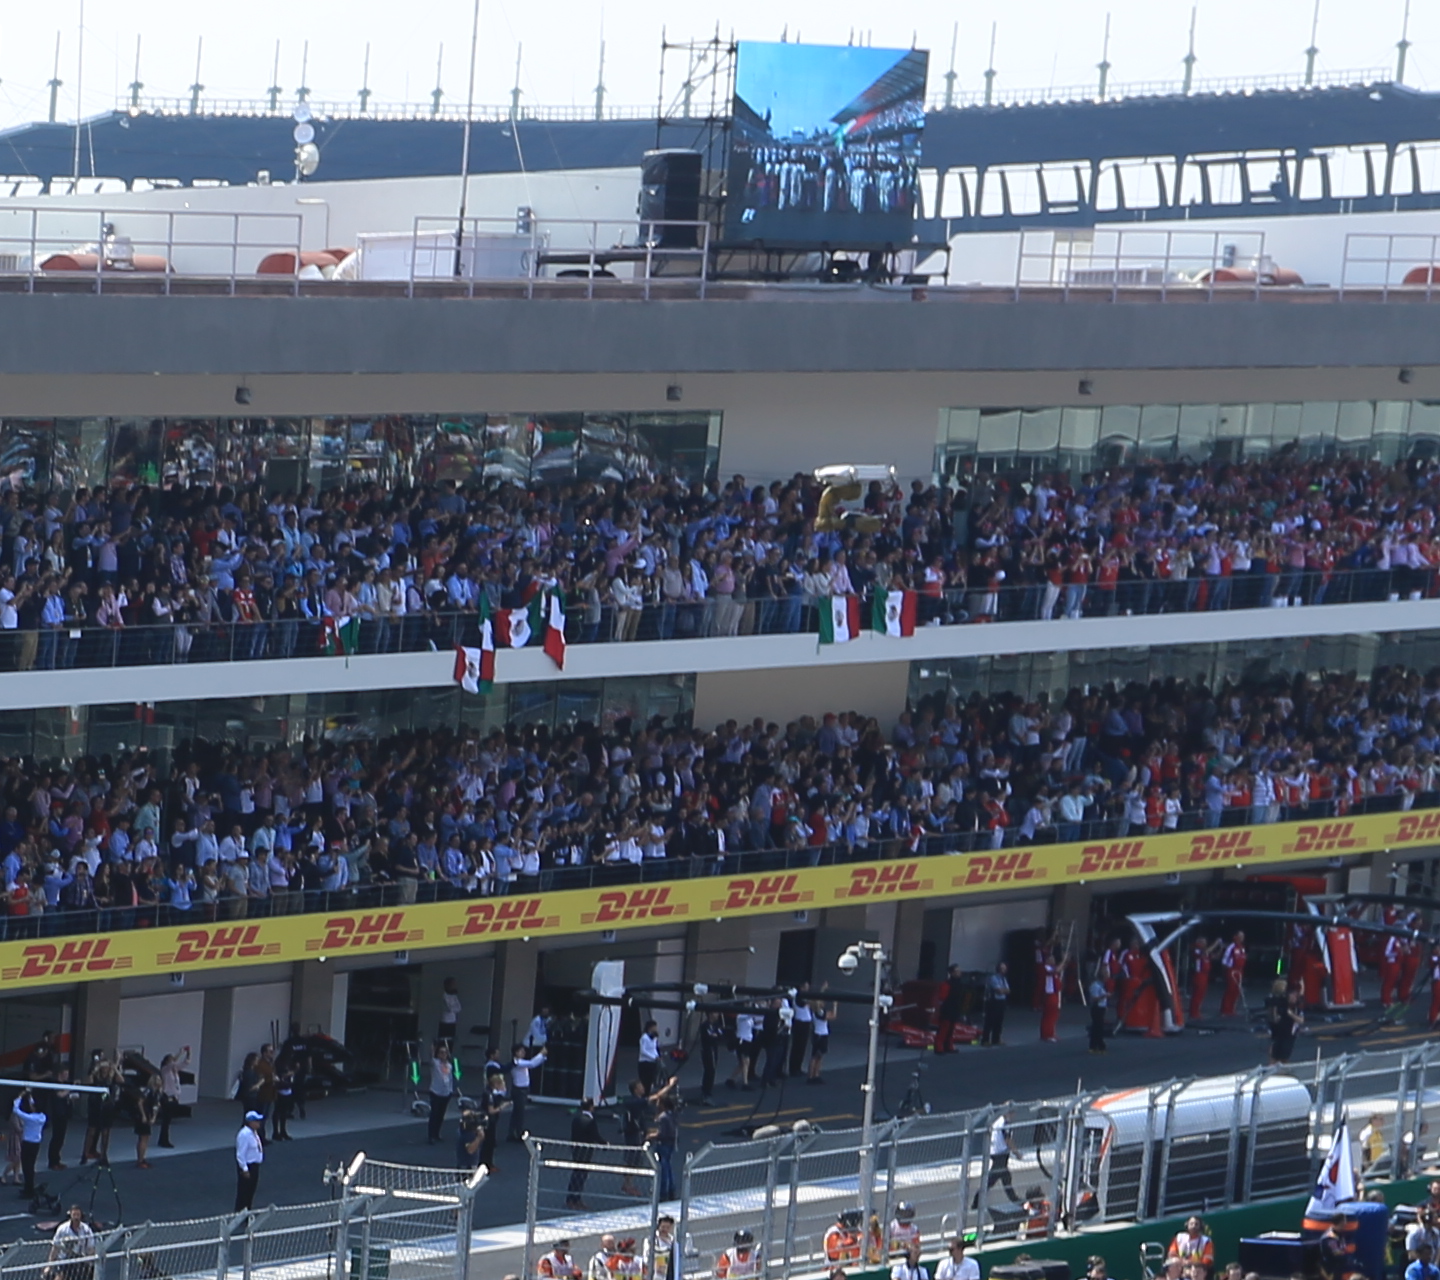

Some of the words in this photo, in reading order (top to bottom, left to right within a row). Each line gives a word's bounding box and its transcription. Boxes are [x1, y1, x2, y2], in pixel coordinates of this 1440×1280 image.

[1295, 823, 1356, 852] DHL
[1396, 814, 1440, 841] DH
[1079, 842, 1149, 873] DHL
[1189, 831, 1254, 862] DHL
[849, 864, 921, 896] DHL
[966, 853, 1034, 885] DHL
[596, 887, 675, 922] DHL
[725, 875, 800, 909] DHL
[323, 913, 408, 949] DHL
[464, 899, 545, 936] DHL
[21, 939, 115, 978] DHL
[175, 926, 264, 963] DHL
